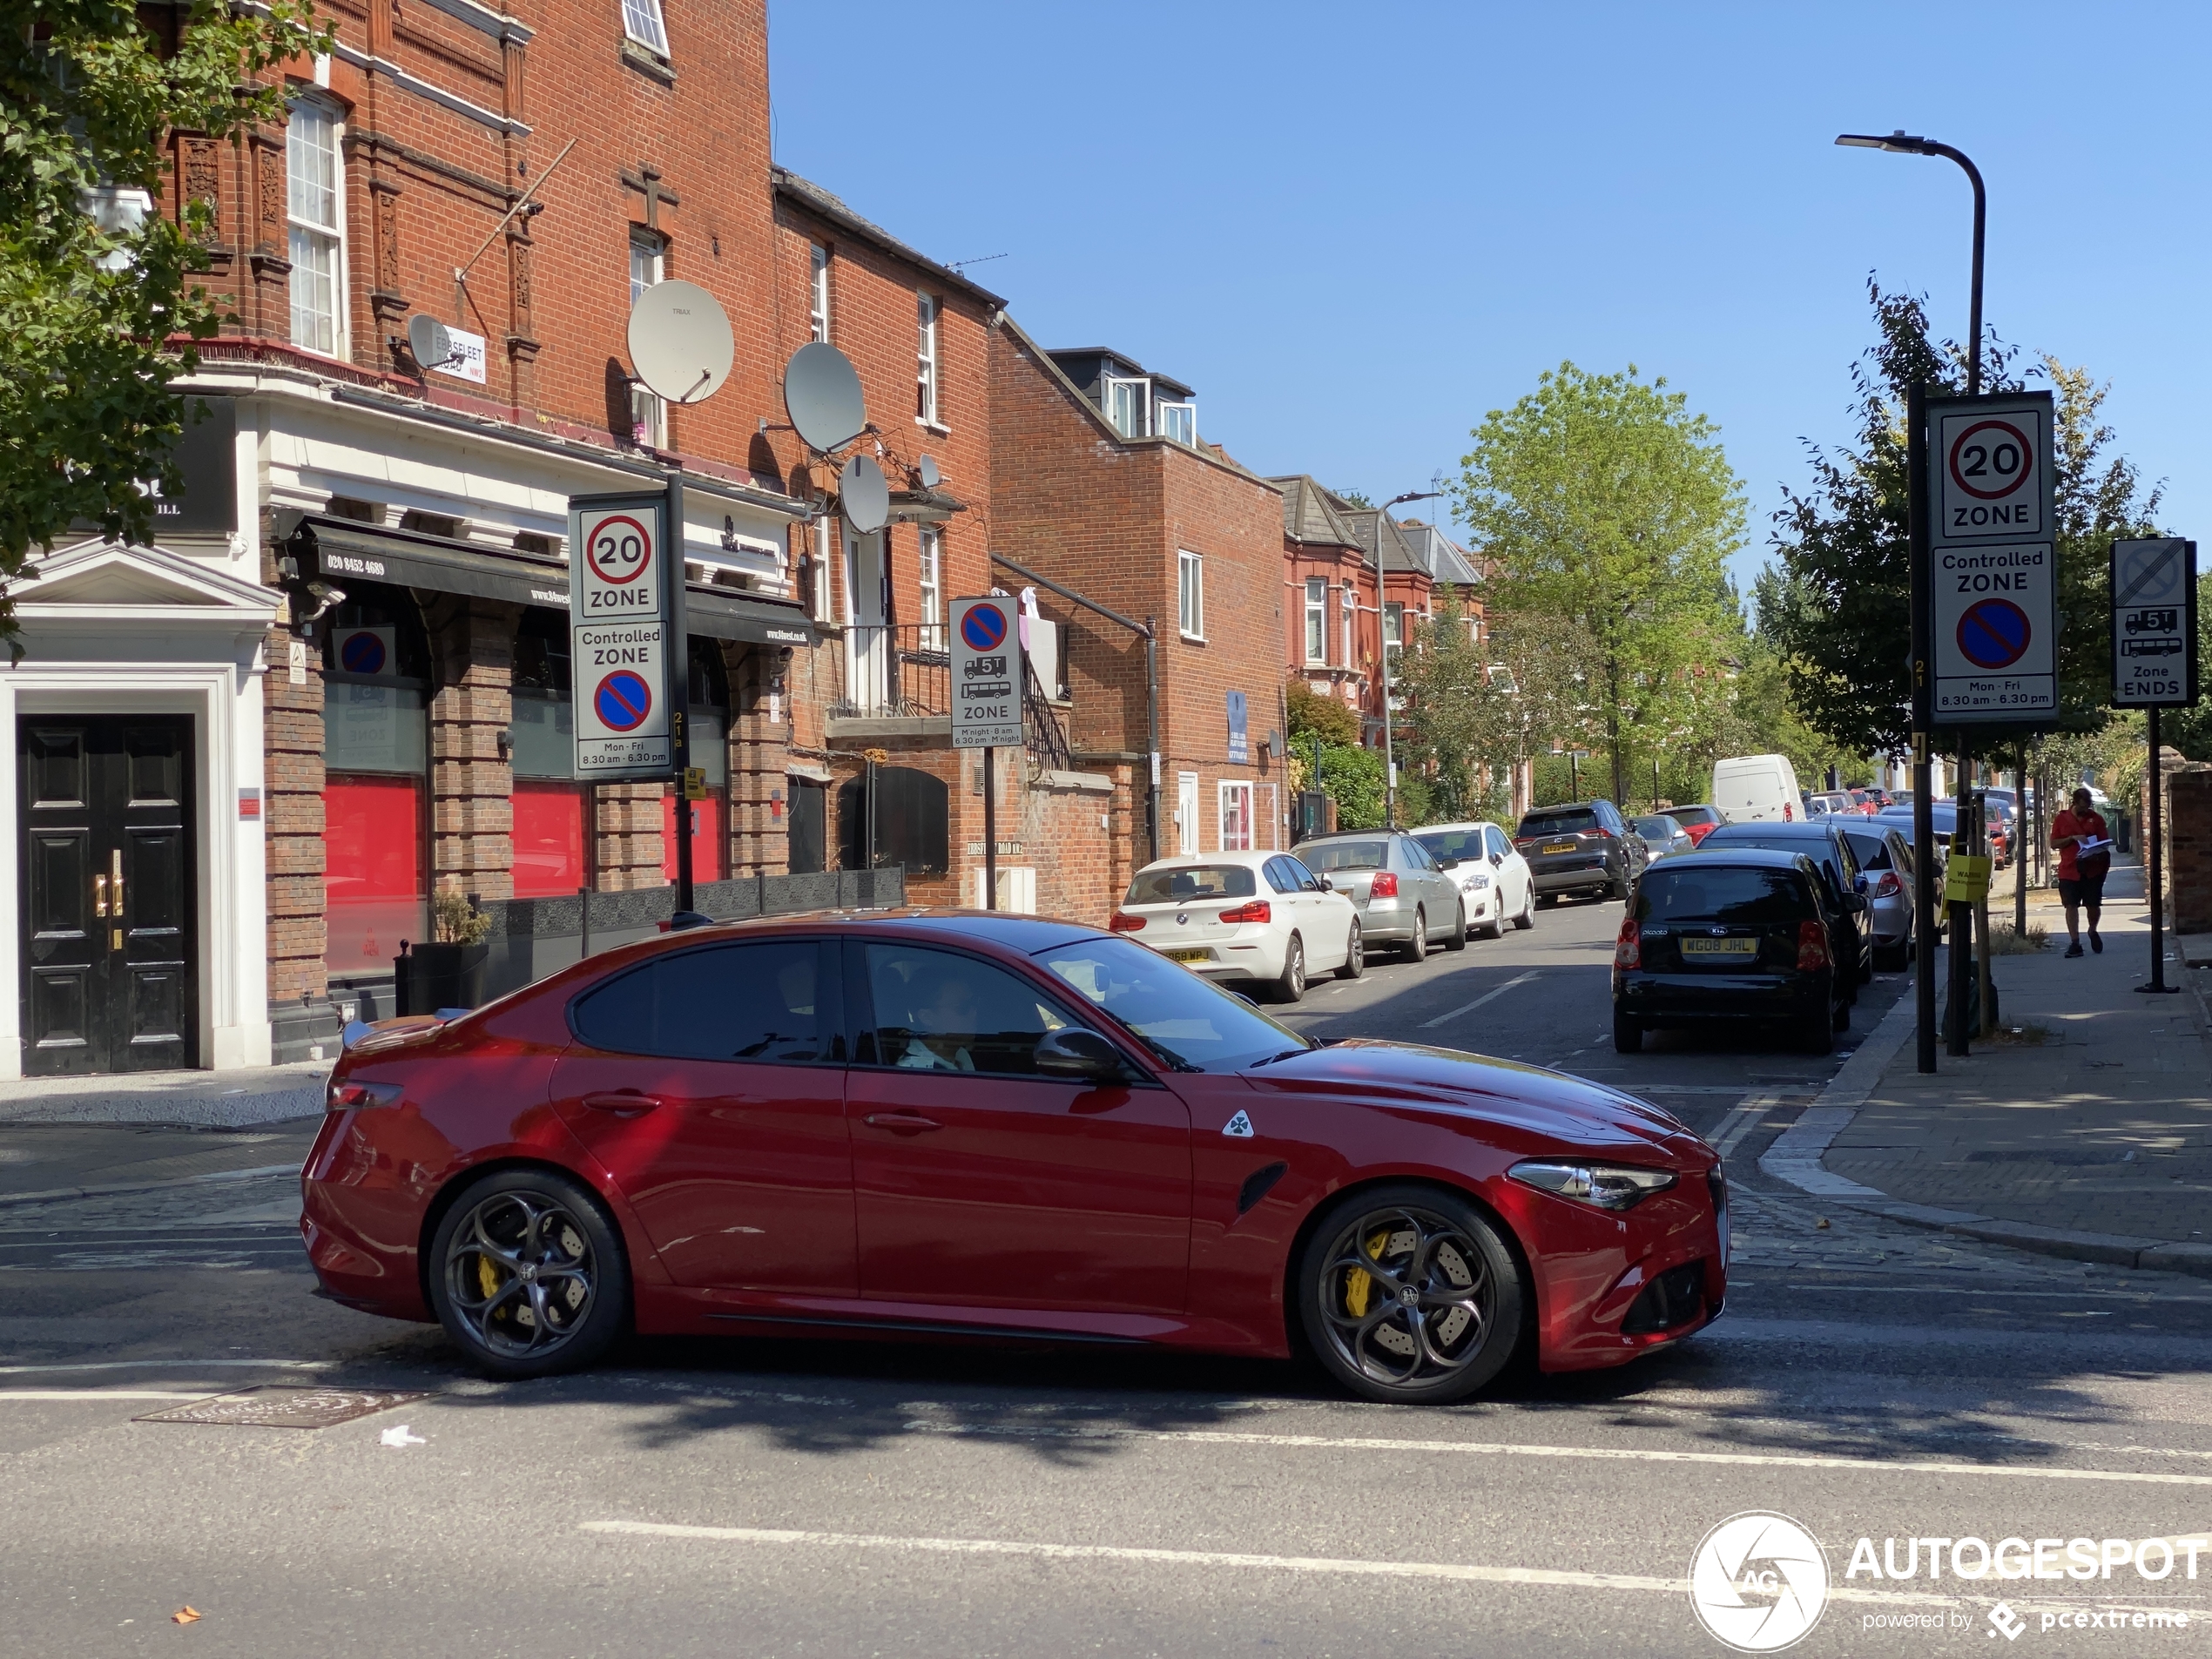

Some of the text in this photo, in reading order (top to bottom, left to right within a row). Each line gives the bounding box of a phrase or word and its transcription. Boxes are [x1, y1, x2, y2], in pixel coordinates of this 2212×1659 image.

[469, 367, 482, 378] NW2
[1963, 443, 2020, 476] 20
[1953, 504, 2029, 527] ZONE
[597, 535, 641, 564] 20
[327, 554, 385, 576] 020 8452 4689
[1942, 550, 2043, 570] Controlled
[1957, 572, 2027, 593] ZONE
[530, 590, 571, 604] www.84west
[590, 588, 649, 607] ZONE
[582, 628, 660, 645] Controlled
[594, 647, 649, 665] ZONE
[2134, 665, 2169, 678] Zone
[1969, 682, 1994, 691] Mon
[2005, 680, 2020, 691] Fri
[2124, 680, 2180, 696] ENDS
[1941, 696, 1970, 706] 8.30
[1973, 696, 1990, 705] am
[2000, 693, 2028, 704] 6.30
[2031, 695, 2049, 705] pm
[964, 705, 1008, 719] ZONE
[604, 743, 624, 752] Mon
[583, 755, 604, 764] 8.30
[628, 753, 650, 762] 6.30
[652, 752, 666, 762] pm
[1724, 940, 1750, 952] JHL
[1190, 951, 1209, 961] WPJ
